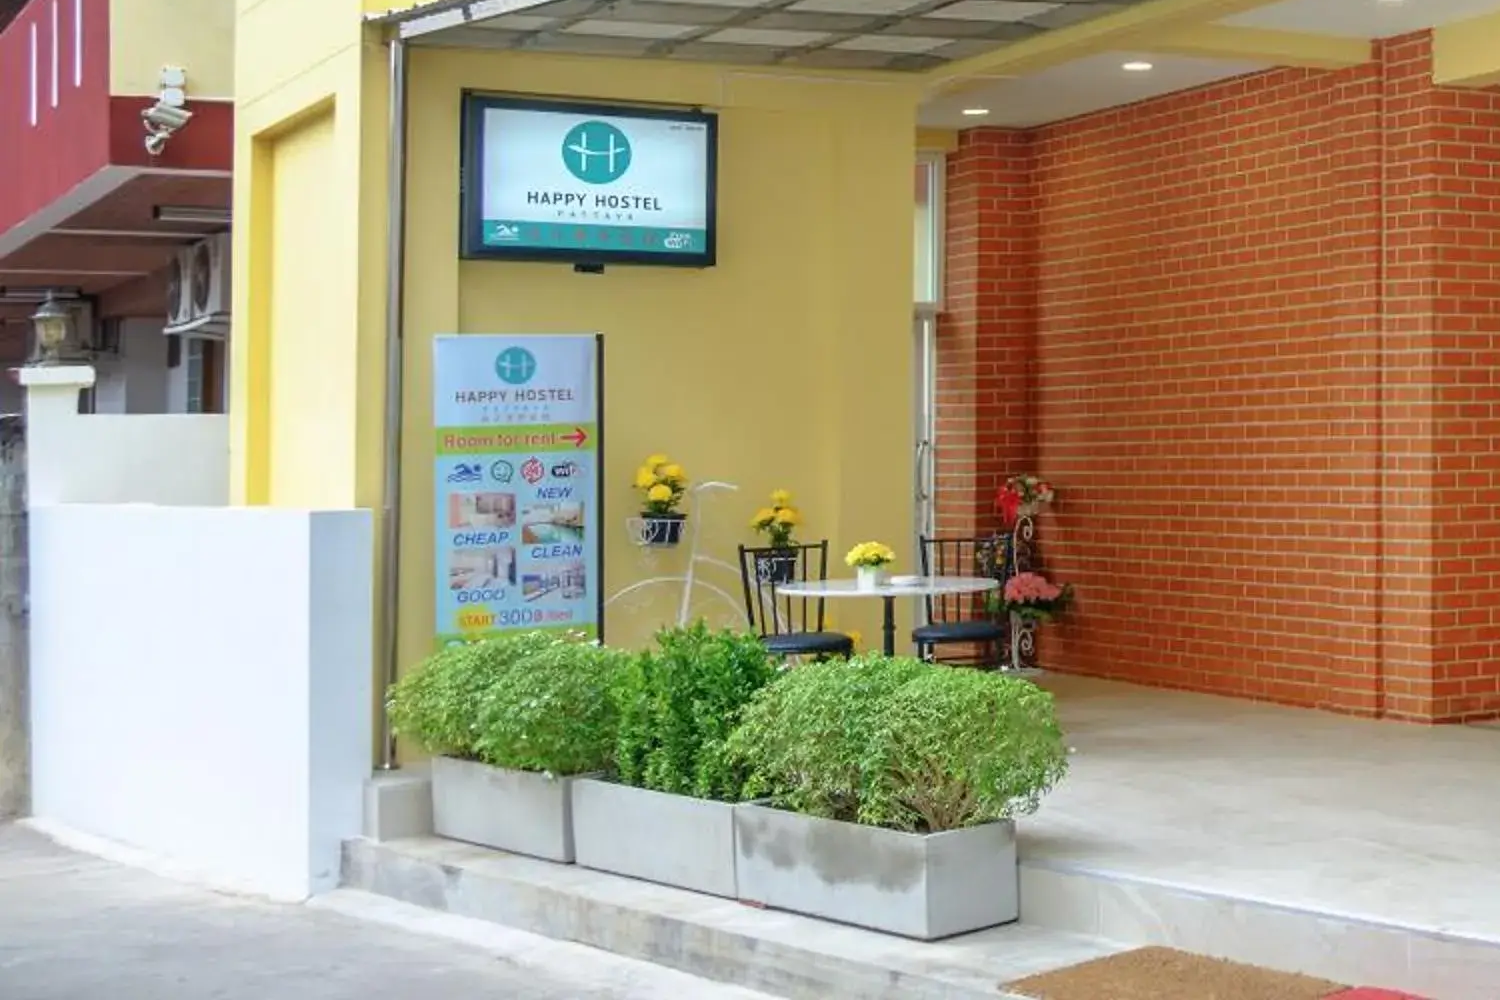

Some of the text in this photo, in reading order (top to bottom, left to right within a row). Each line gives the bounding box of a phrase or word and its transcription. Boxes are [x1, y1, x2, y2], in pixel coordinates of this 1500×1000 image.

[527, 191, 662, 211] HAPPY HOSTEL
[455, 388, 575, 404] HAPPY HOSTEL
[444, 432, 555, 448] Room for rent
[537, 487, 573, 499] NEW
[453, 531, 509, 546] CHEAP
[531, 544, 583, 559] CLEAN
[457, 588, 505, 603] GOOD
